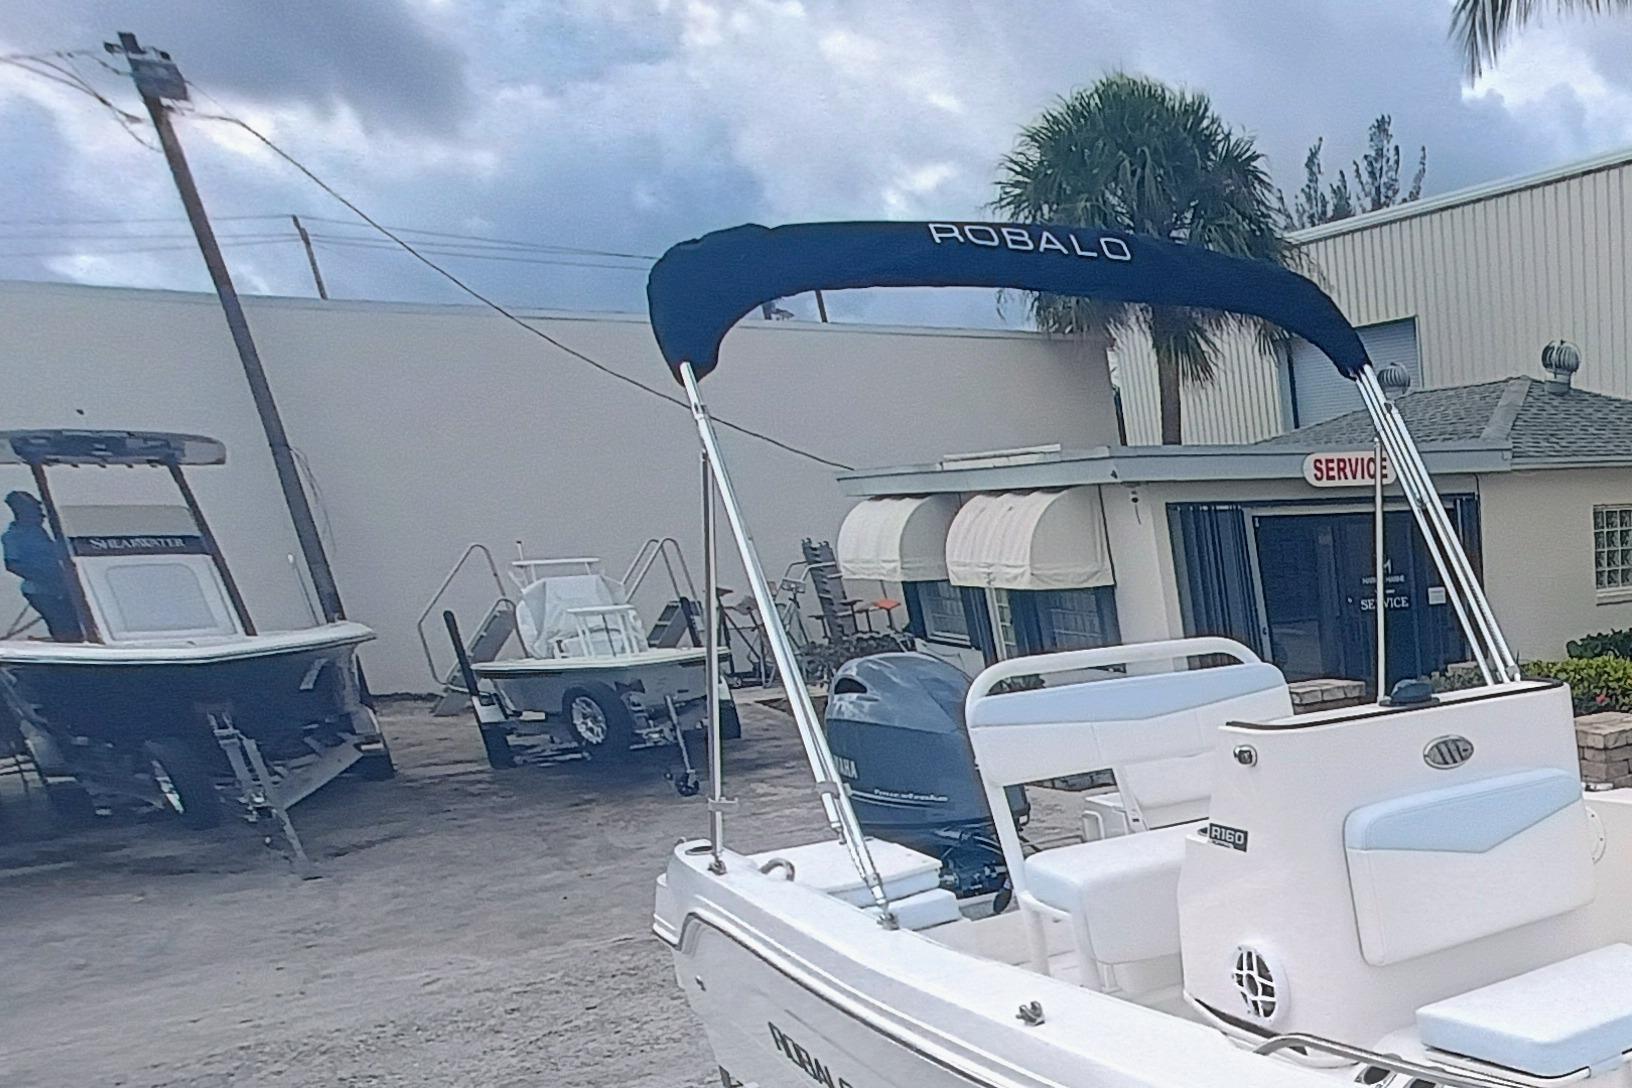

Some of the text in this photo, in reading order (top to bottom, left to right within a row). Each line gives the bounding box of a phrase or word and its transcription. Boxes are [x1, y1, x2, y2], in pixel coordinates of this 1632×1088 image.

[928, 223, 1132, 261] ROBALO
[1313, 457, 1388, 481] SERVICE
[1360, 596, 1409, 611] SEVICE
[1211, 826, 1245, 845] R160
